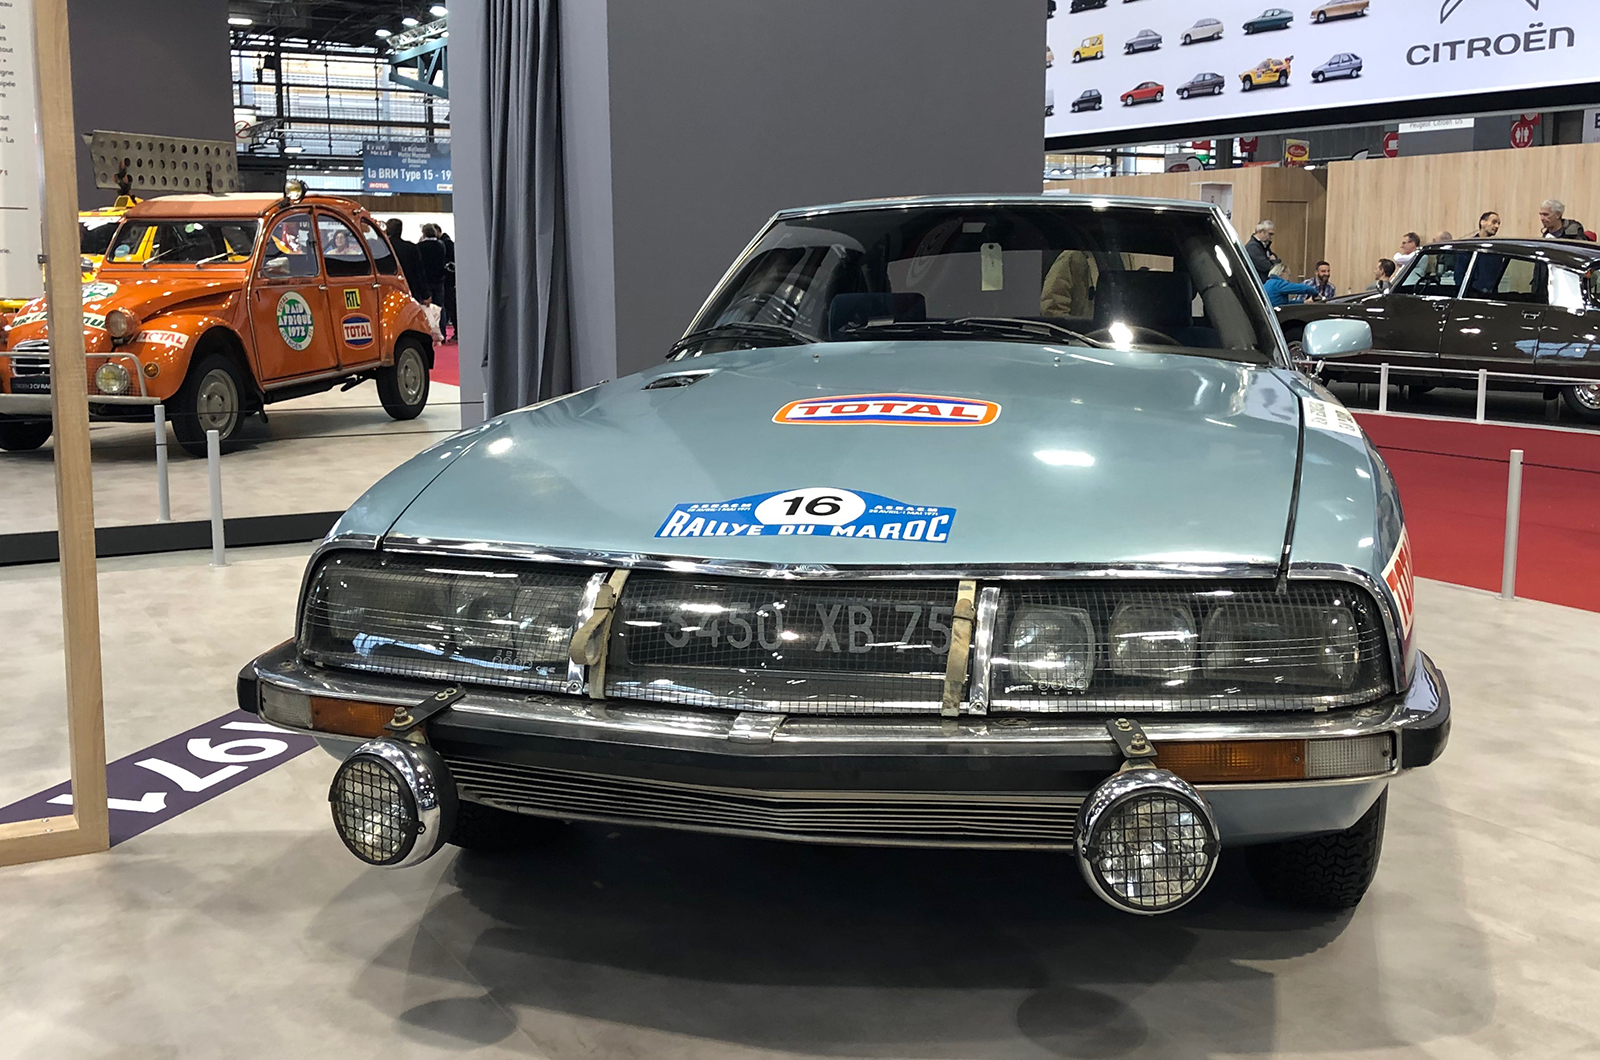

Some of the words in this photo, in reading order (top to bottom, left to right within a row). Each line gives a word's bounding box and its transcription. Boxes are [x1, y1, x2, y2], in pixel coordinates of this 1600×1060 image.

[1406, 22, 1575, 66] CITROËN
[378, 167, 399, 179] BRM
[401, 168, 421, 182] Type
[423, 169, 434, 180] 15
[344, 290, 360, 308] RTL
[344, 325, 372, 338] TOTAL
[798, 402, 979, 419] TOTAL
[783, 496, 844, 517] 16
[660, 509, 765, 537] RALLYE
[778, 524, 815, 536] DU
[830, 514, 950, 542] MAROC
[663, 602, 784, 651] 3450
[814, 603, 874, 654] XB
[894, 605, 952, 655] 75
